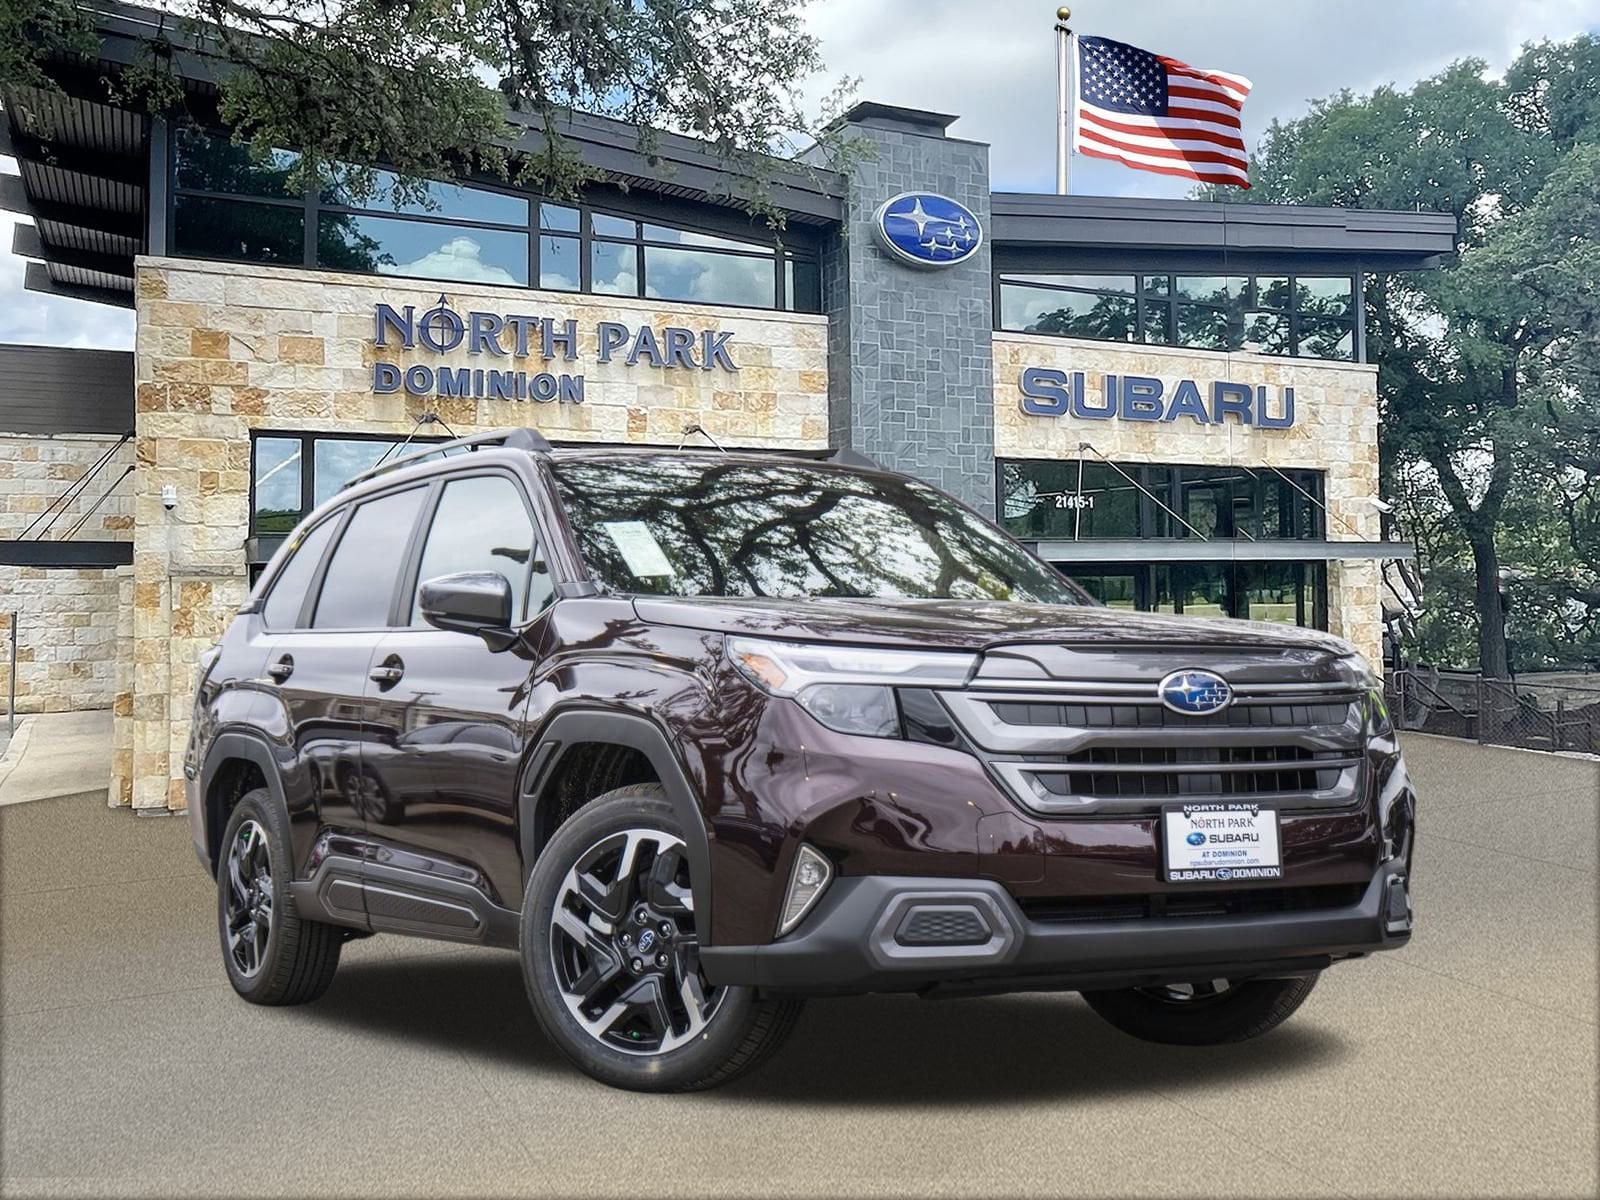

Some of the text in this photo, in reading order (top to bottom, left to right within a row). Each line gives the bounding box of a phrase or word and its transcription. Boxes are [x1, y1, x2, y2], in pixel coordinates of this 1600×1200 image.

[375, 293, 742, 373] NORTH PARK
[373, 362, 584, 403] DOMINION
[1019, 367, 1295, 430] SUBARU
[1190, 817, 1255, 829] NORTH PARK
[1209, 833, 1259, 844] SUBARU
[1212, 850, 1248, 858] DOMINION
[1170, 868, 1280, 880] SUBARU DOMINION
